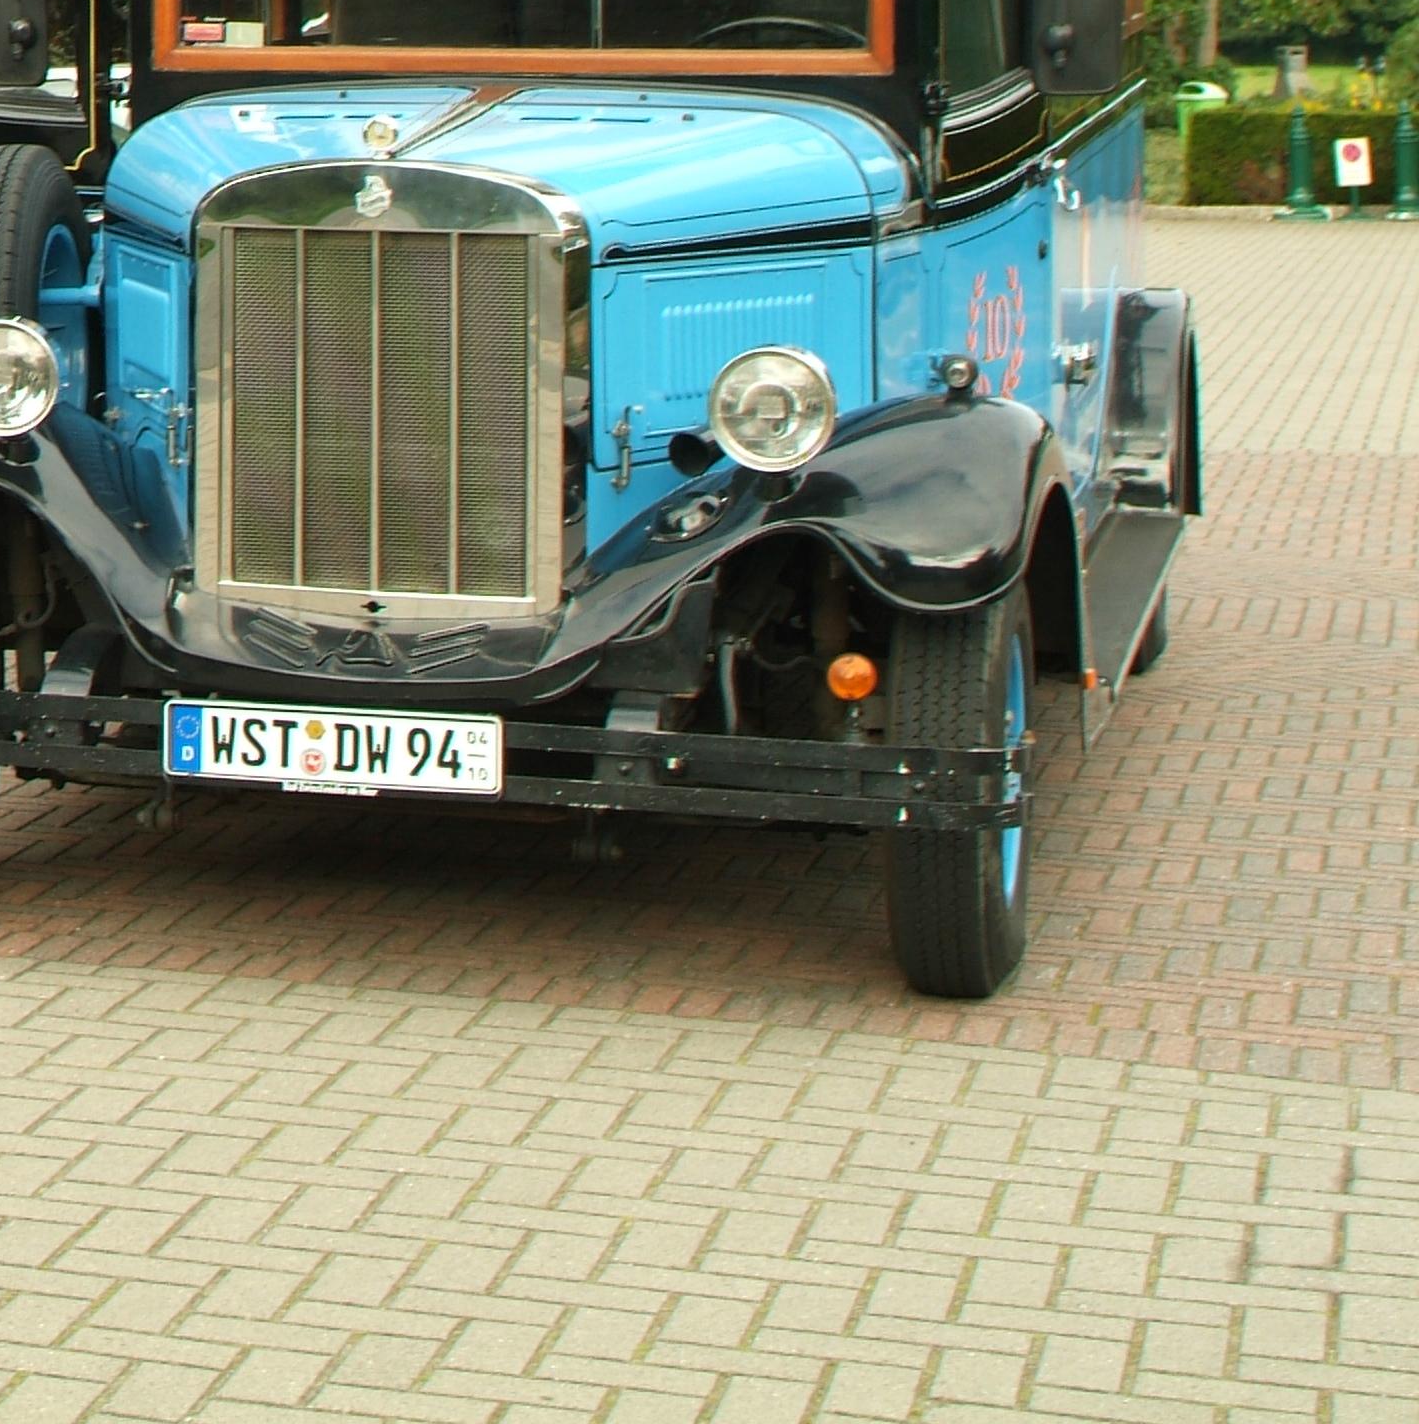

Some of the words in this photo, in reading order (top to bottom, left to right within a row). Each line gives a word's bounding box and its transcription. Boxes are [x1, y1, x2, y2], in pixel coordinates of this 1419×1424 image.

[983, 294, 1010, 361] 10
[181, 745, 195, 762] D
[211, 714, 299, 769] WST
[333, 722, 391, 774] DW
[406, 726, 461, 779] 94
